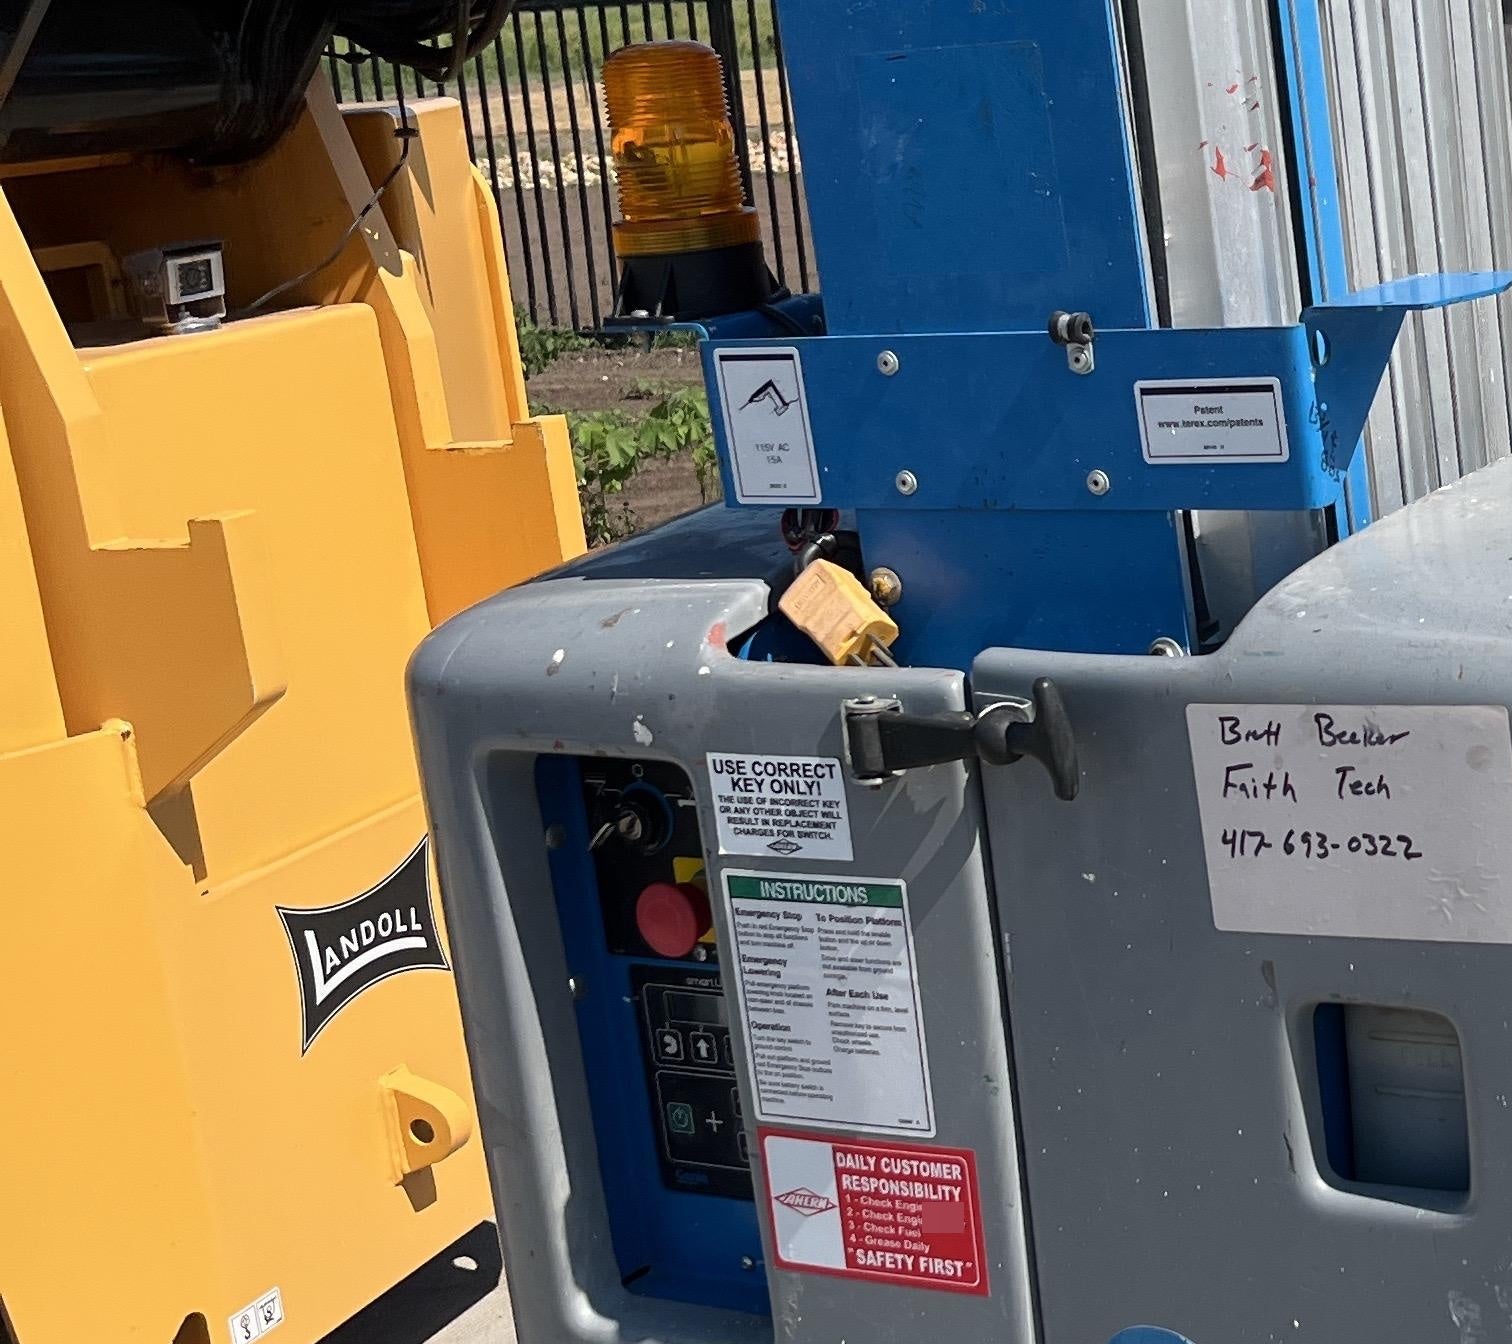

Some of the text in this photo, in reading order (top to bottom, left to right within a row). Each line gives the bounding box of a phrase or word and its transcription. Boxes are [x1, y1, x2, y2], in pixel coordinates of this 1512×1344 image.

[1193, 405, 1224, 414] Patent
[1158, 418, 1264, 429] www.terex.com/patents
[712, 758, 836, 779] USE CORRECT
[731, 776, 822, 796] KEY ONLY!
[1223, 762, 1391, 803] Faith Tech
[718, 794, 840, 808] THE USE OF INCORRECT KEY
[719, 805, 842, 819] OR ANY OTHER OBJECT WILL
[726, 816, 837, 829] RESULT IN REPLACEMENT
[733, 827, 775, 837] CHARGES
[776, 829, 795, 838] FOR
[760, 879, 870, 904] INSTRUCTIONS
[734, 907, 802, 921] Emergency Stop
[815, 912, 826, 922] To
[828, 913, 864, 924] Position
[303, 906, 428, 1006] LANDOLL
[741, 953, 788, 968] Emergency
[743, 965, 781, 978] Lowering
[826, 988, 889, 1001] After Each Use
[751, 1020, 791, 1032] Operation
[835, 1151, 963, 1181] DAILY CUSTOMER
[841, 1173, 962, 1202] RESPONSIBILITY
[845, 1193, 852, 1203] 1
[859, 1195, 893, 1208] Check
[846, 1206, 854, 1217] 2
[861, 1208, 895, 1222] Check
[848, 1220, 855, 1230] 3
[862, 1222, 896, 1235] Check
[849, 1233, 857, 1243] 4
[864, 1235, 902, 1248] Grease
[903, 1239, 931, 1254] Daily
